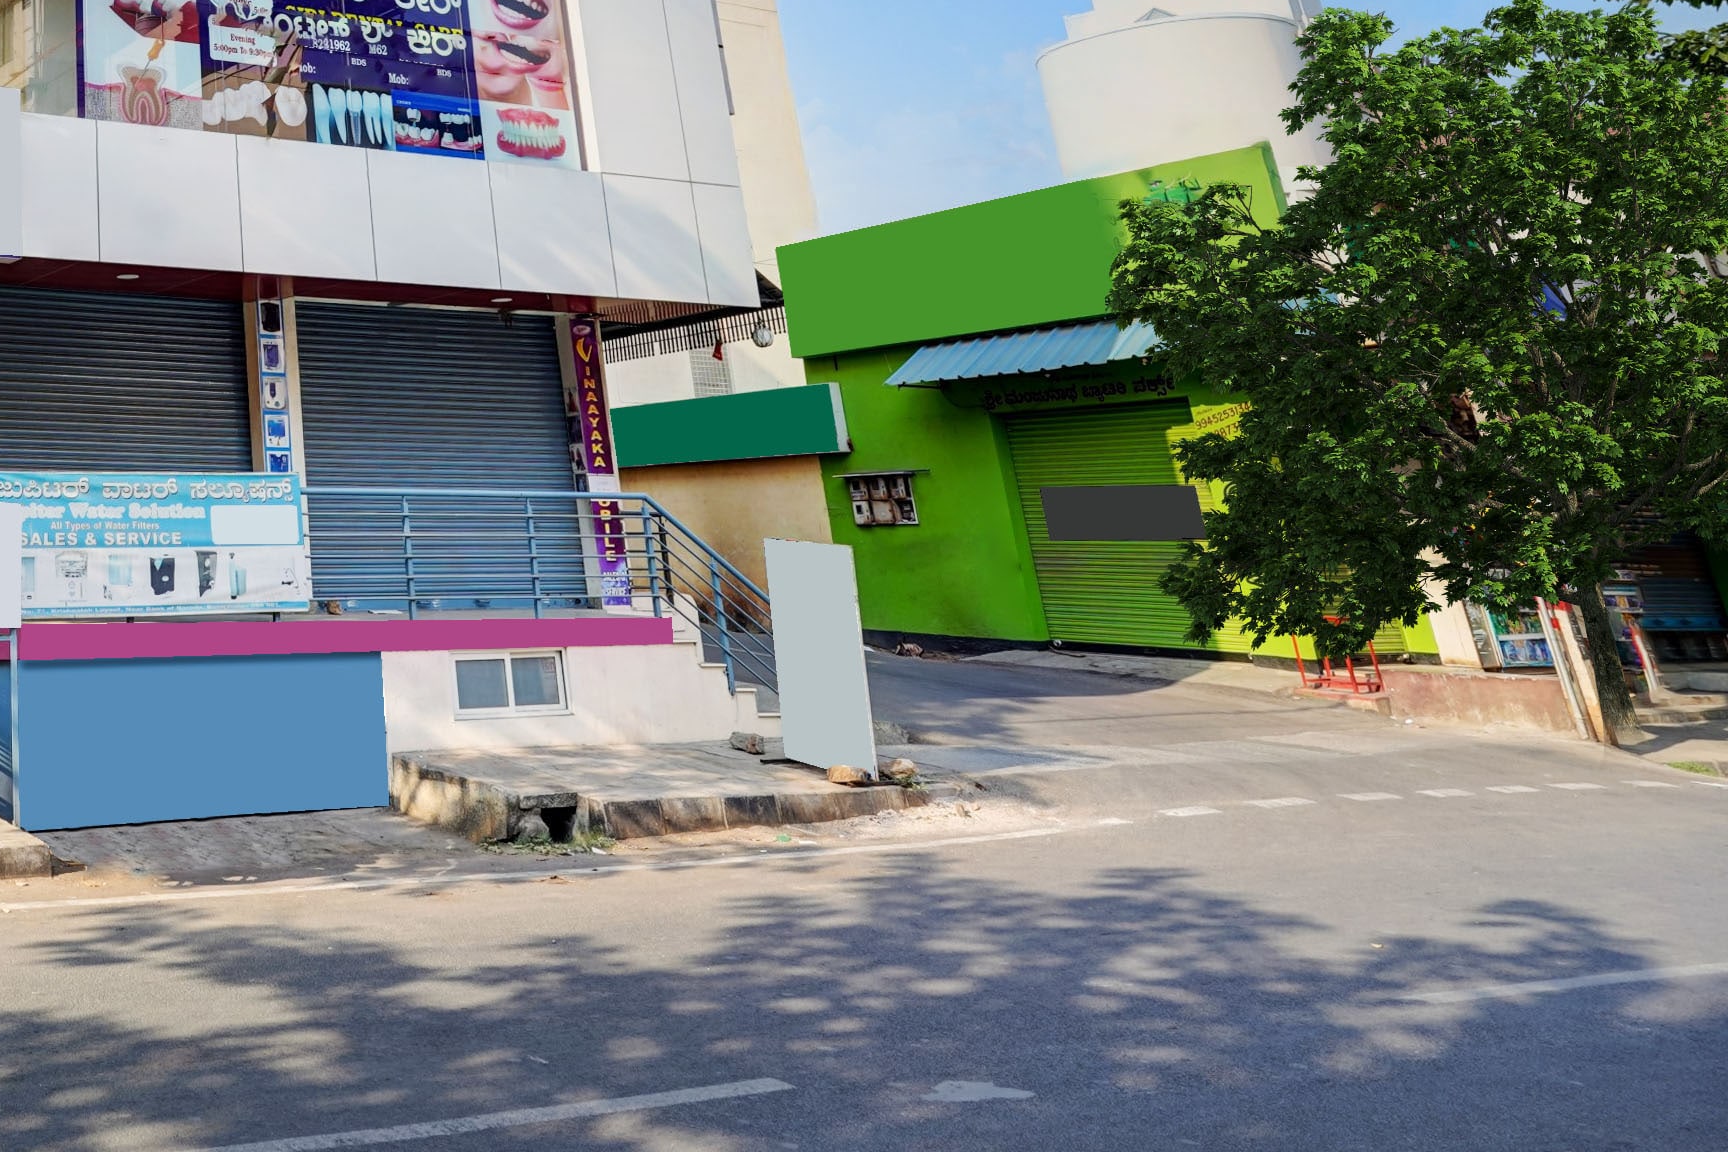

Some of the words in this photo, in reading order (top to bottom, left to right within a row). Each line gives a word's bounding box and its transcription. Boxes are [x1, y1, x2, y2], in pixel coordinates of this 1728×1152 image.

[230, 33, 256, 46] Evening
[240, 46, 248, 54] To
[351, 57, 367, 67] BDS
[388, 72, 409, 85] Mob:
[436, 68, 452, 78] BDS
[575, 336, 606, 468] VINAAYAKA
[102, 477, 177, 500] ವಾಟರ್
[68, 501, 126, 519] Water
[128, 502, 207, 519] Solution
[50, 520, 63, 530] All
[65, 520, 91, 531] Types
[93, 520, 103, 530] of
[105, 520, 130, 530] Water
[132, 520, 160, 530] Filters
[21, 531, 77, 546] SALES
[84, 532, 97, 545] &
[104, 532, 183, 546] SERVICE
